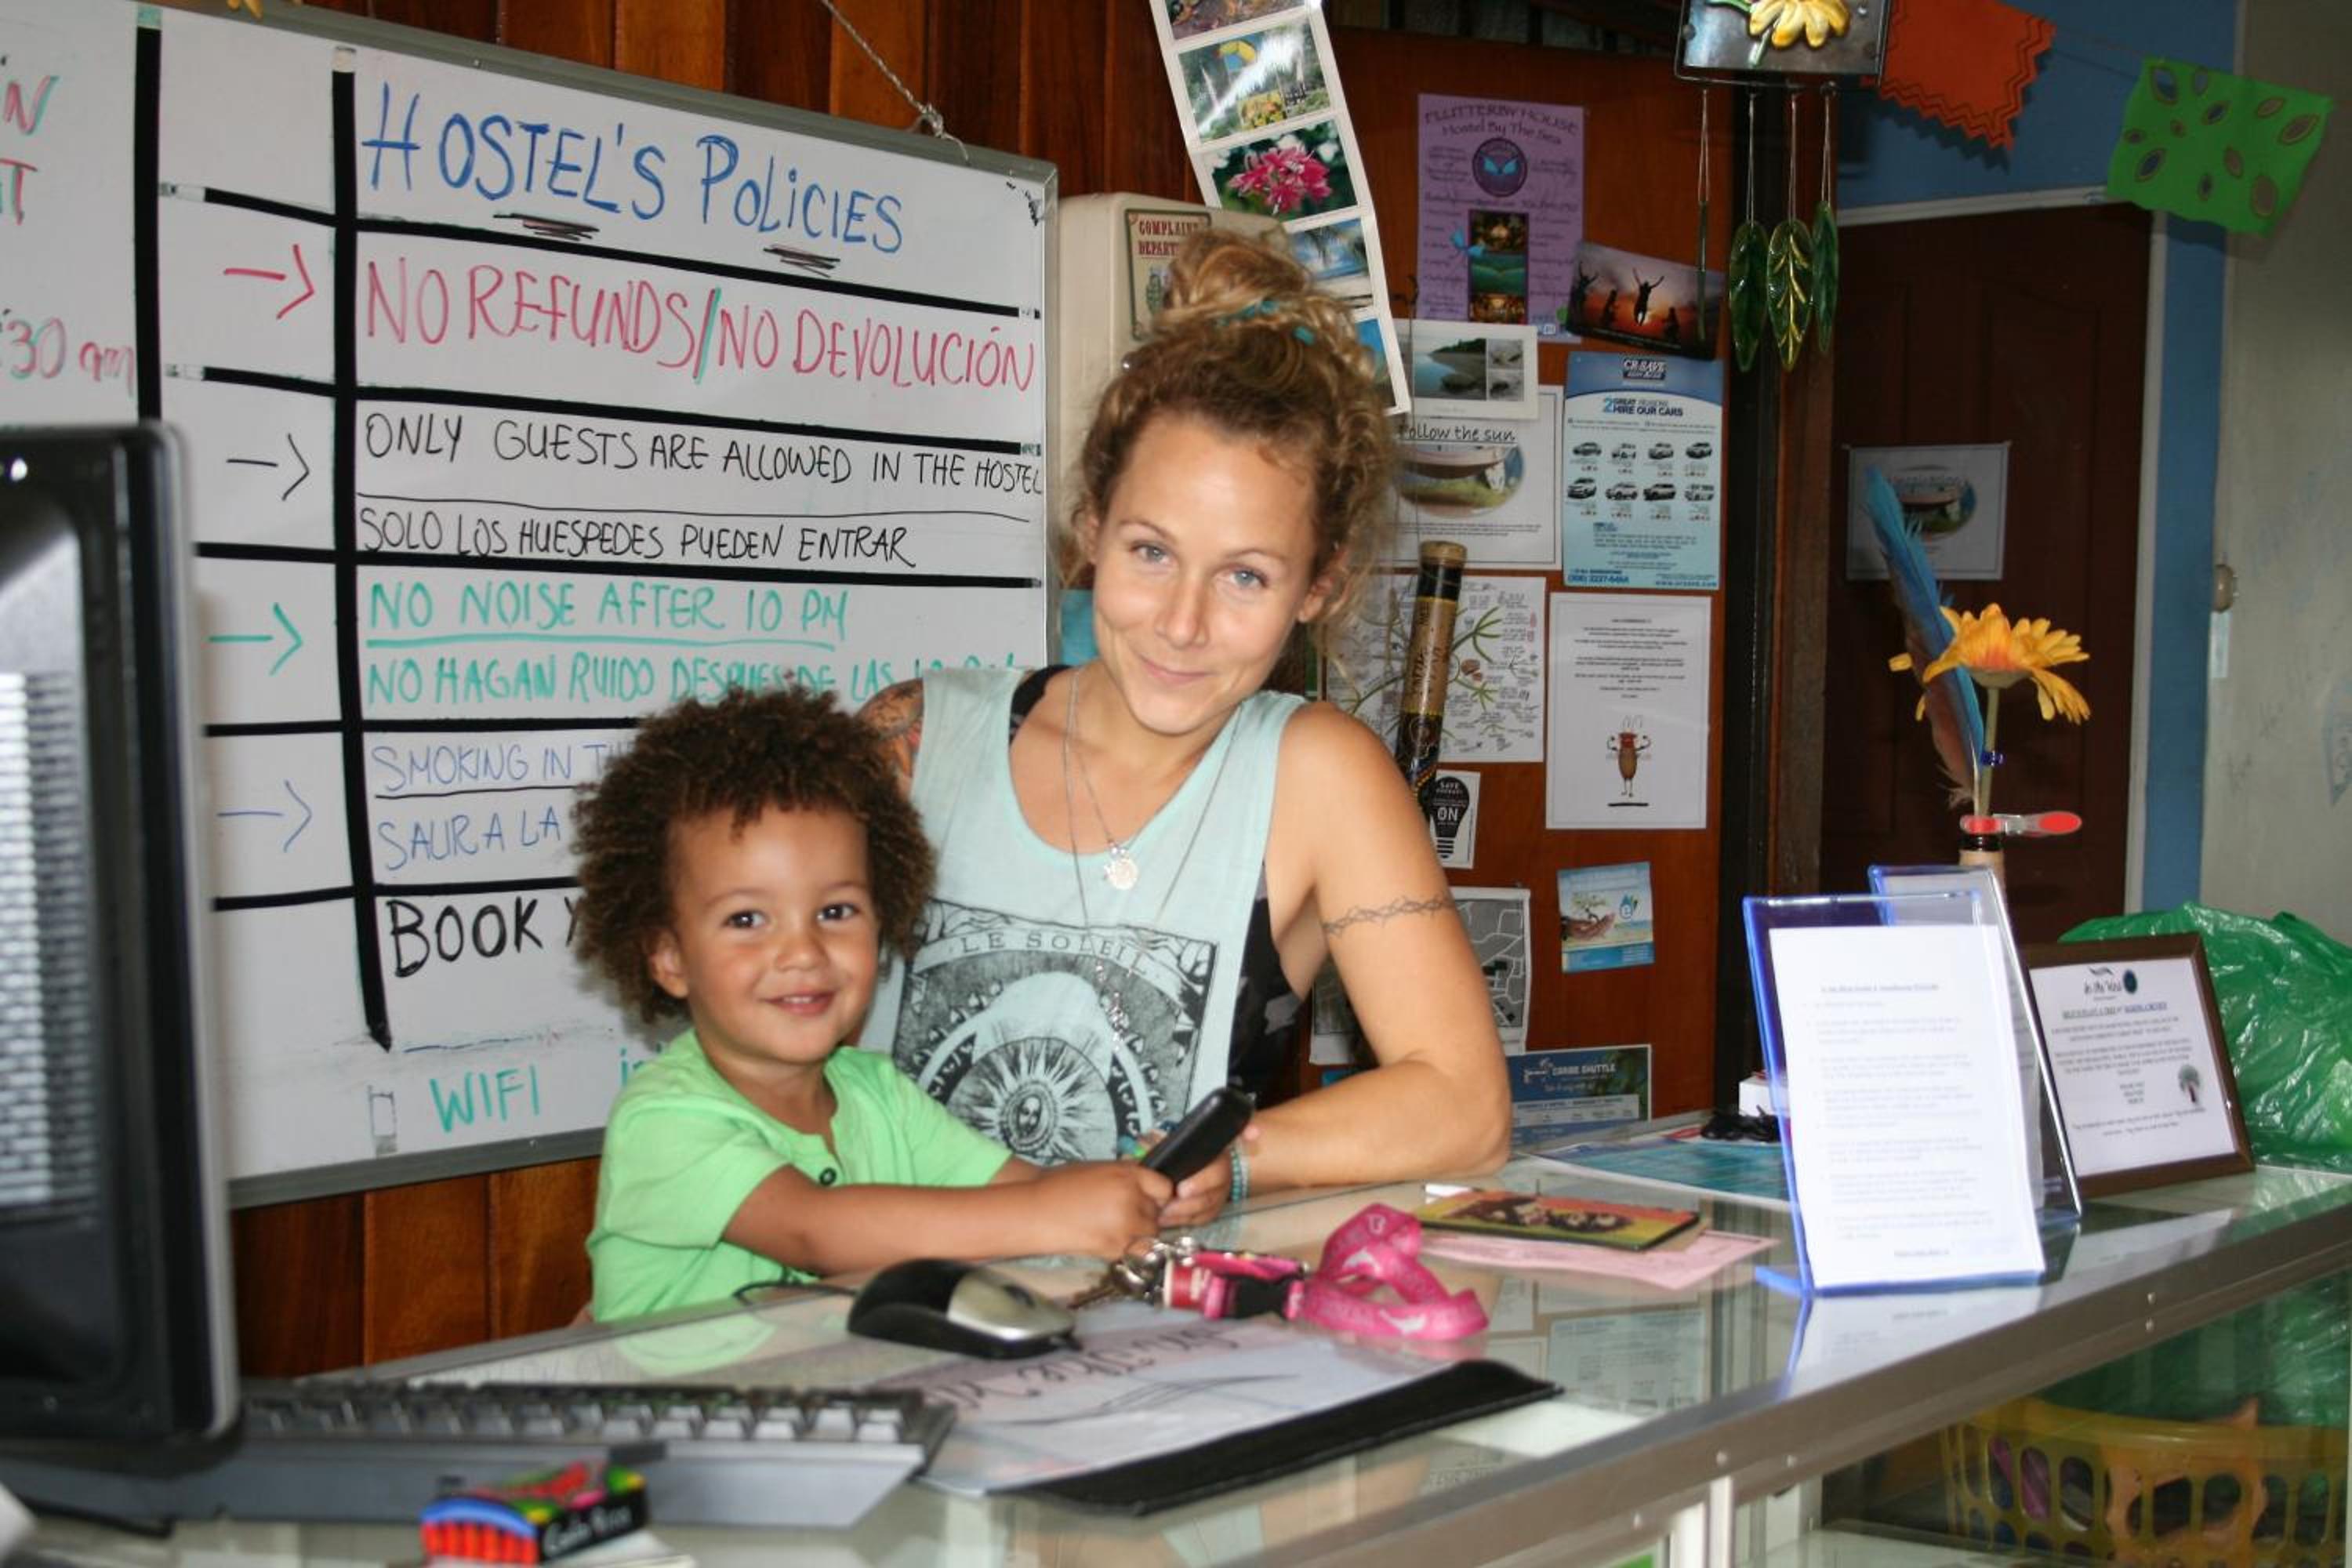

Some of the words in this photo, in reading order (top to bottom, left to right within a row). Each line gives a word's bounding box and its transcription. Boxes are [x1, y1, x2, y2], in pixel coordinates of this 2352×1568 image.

[361, 82, 666, 220] HOSTEL'S
[1138, 241, 1179, 256] DEPART
[368, 257, 448, 343] NO
[793, 309, 1033, 390] DEVOLUCIÓN
[79, 342, 134, 397] am
[1454, 424, 1479, 440] the
[1484, 429, 1515, 441] sun
[1637, 406, 1657, 415] OUR
[1659, 407, 1683, 416] CARS
[366, 412, 462, 463] ONLY
[494, 419, 637, 469] GUESTS
[651, 434, 709, 469] ARE
[723, 441, 851, 483] ALLOWED
[873, 451, 902, 482] IN
[914, 453, 965, 486] THE
[975, 458, 1043, 494] HOSTEL
[360, 507, 443, 550] SOLO
[457, 514, 507, 557] LOS
[520, 519, 664, 558] HUESPEDES
[681, 524, 783, 559] PUEDEN
[798, 525, 916, 568] ENTRAR
[369, 581, 433, 629] NO
[460, 580, 575, 630] NOISE
[598, 581, 724, 629] AFTER
[746, 590, 782, 630] 10
[802, 590, 849, 640] PM
[368, 659, 423, 703] NO
[436, 653, 557, 702] HAGAN
[569, 652, 655, 702] RUIDO
[851, 659, 895, 702] LAS
[371, 745, 529, 792] SMOKING
[543, 746, 572, 781] IN
[482, 812, 505, 851] A
[520, 805, 561, 846] LA
[1437, 807, 1459, 821] ON
[386, 896, 543, 978] BOOK
[960, 933, 1005, 953] LE
[1026, 932, 1149, 975] SOLEIL
[430, 1065, 541, 1133] WIFI
